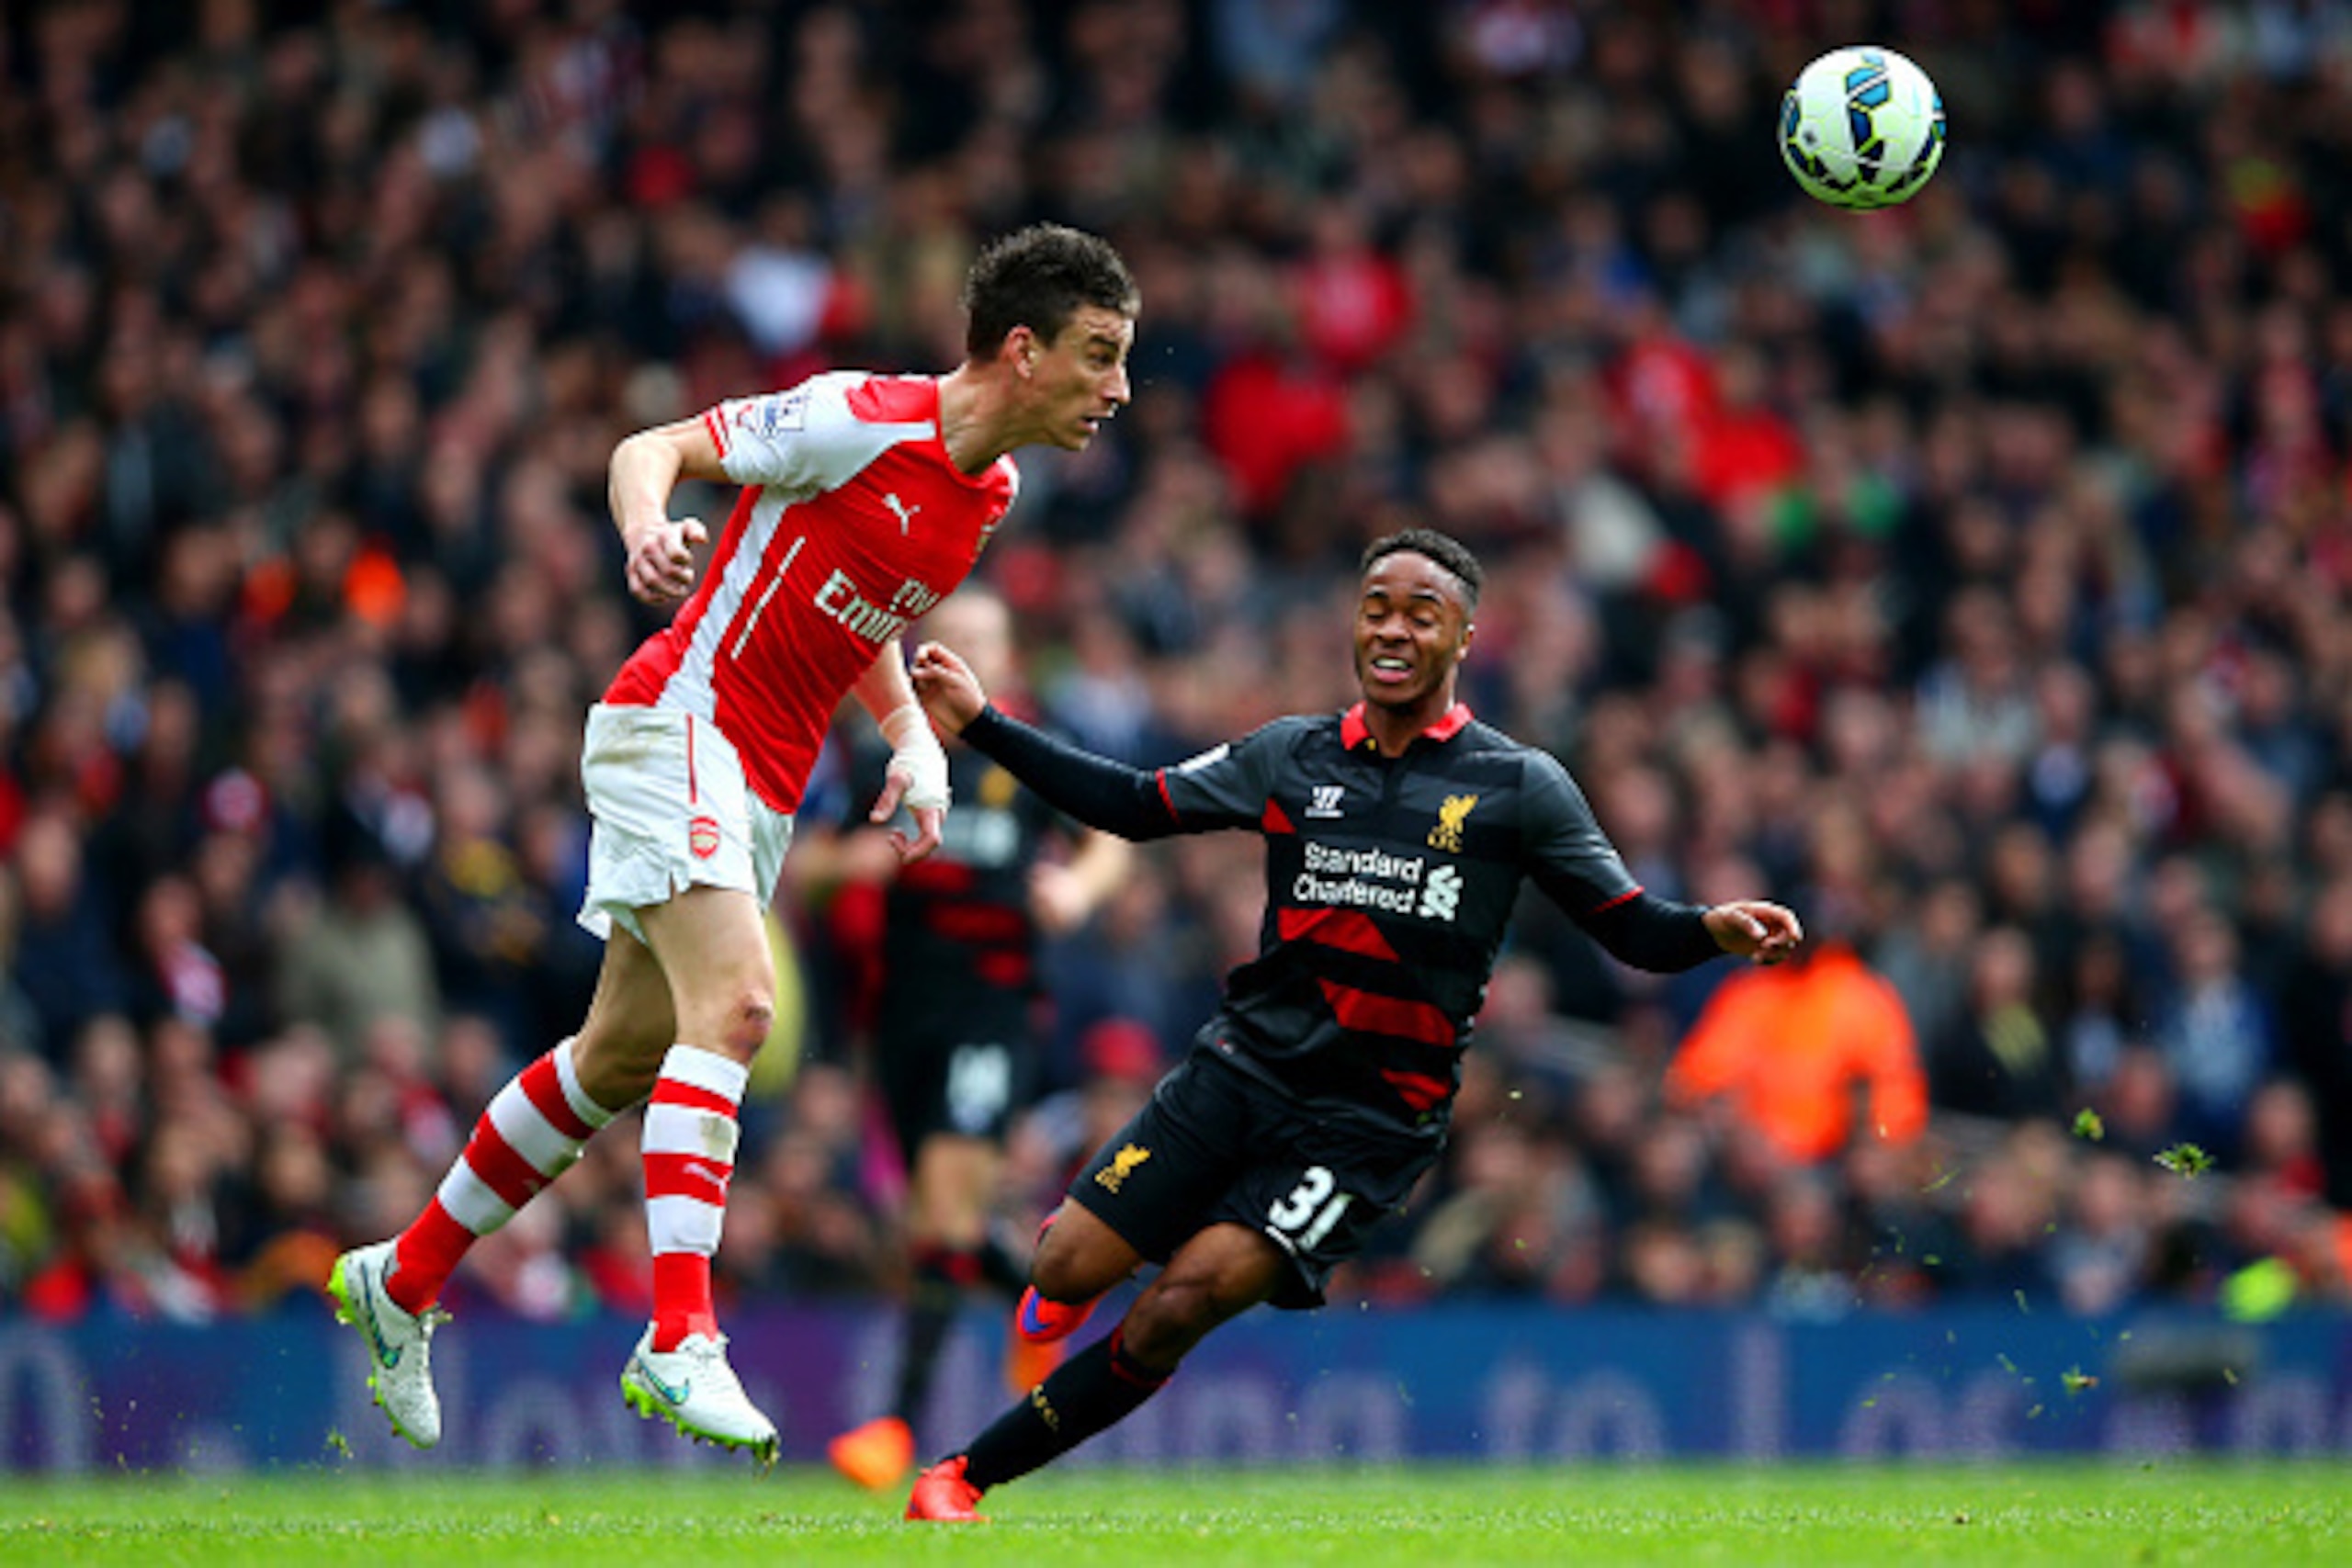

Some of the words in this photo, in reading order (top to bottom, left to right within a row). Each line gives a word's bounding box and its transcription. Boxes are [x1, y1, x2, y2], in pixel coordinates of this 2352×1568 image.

[1304, 841, 1424, 884] Standard
[1292, 873, 1417, 914] Chartered
[1269, 1166, 1356, 1250] 31
